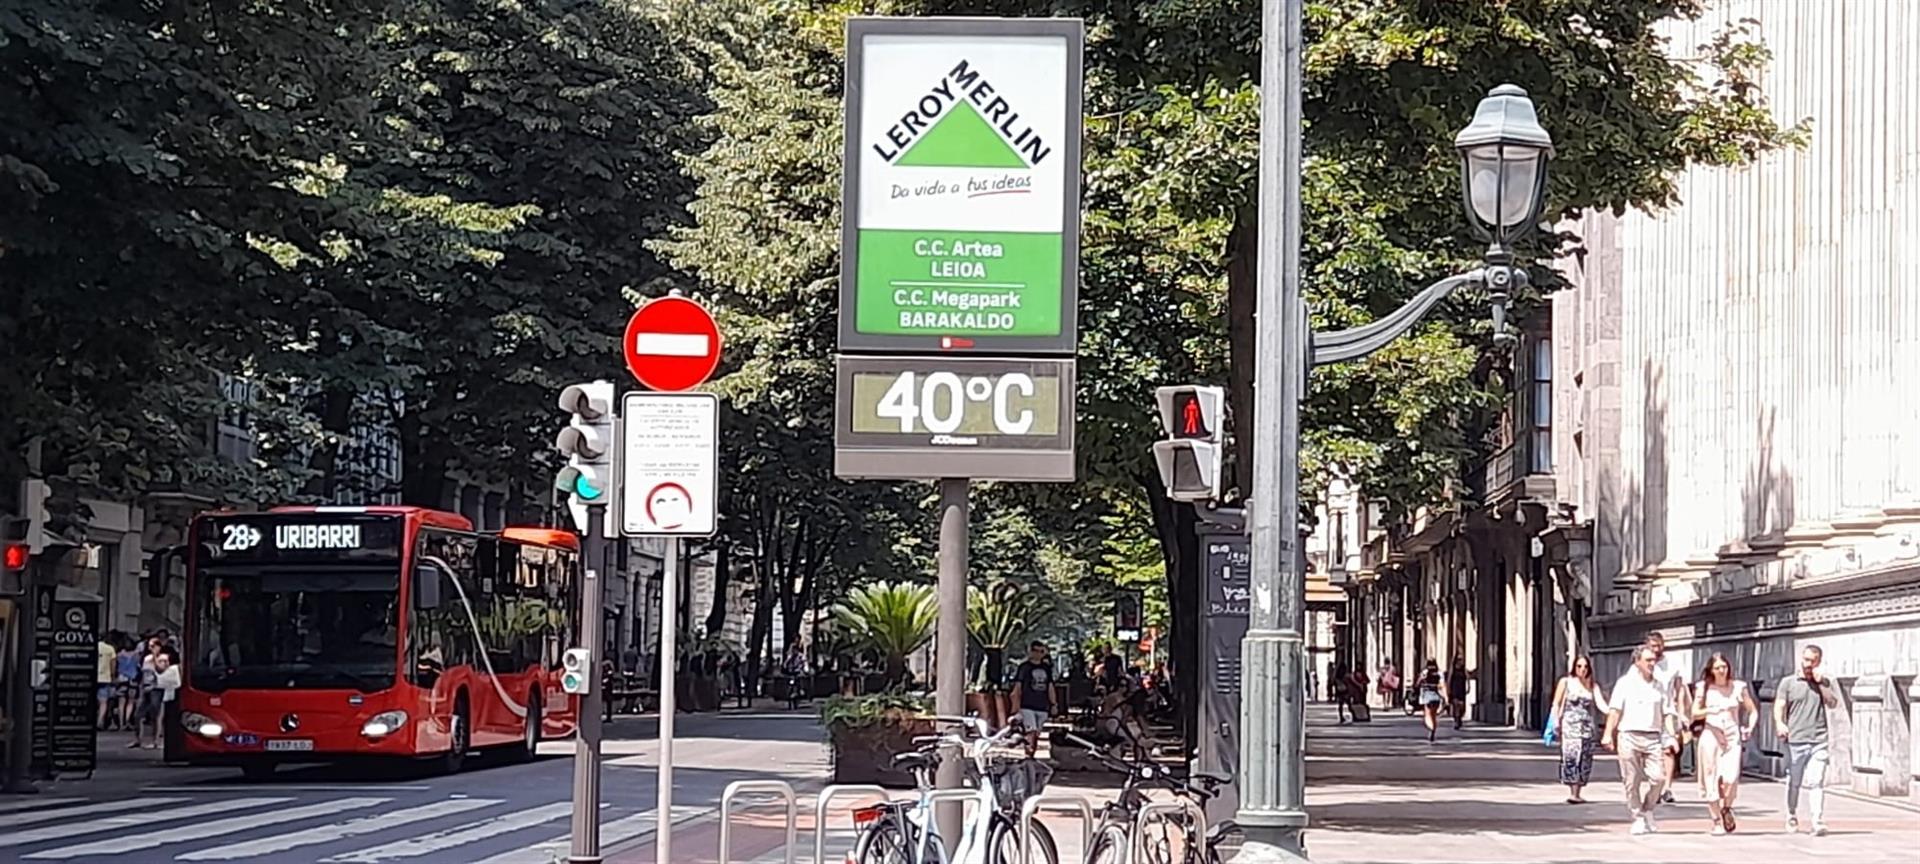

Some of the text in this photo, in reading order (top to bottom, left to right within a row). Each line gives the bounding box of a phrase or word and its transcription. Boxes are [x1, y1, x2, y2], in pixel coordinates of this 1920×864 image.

[872, 59, 1052, 165] LEROY MERLIN
[891, 174, 1032, 199] Da vida a tus ideas
[914, 240, 1004, 258] C.C. Artea
[931, 261, 986, 278] LEIOA
[894, 289, 1021, 311] C.C. Megapark
[899, 312, 1015, 330] BARAKALDO
[223, 524, 361, 550] 28 URIBARRI
[55, 631, 95, 644] GOYA
